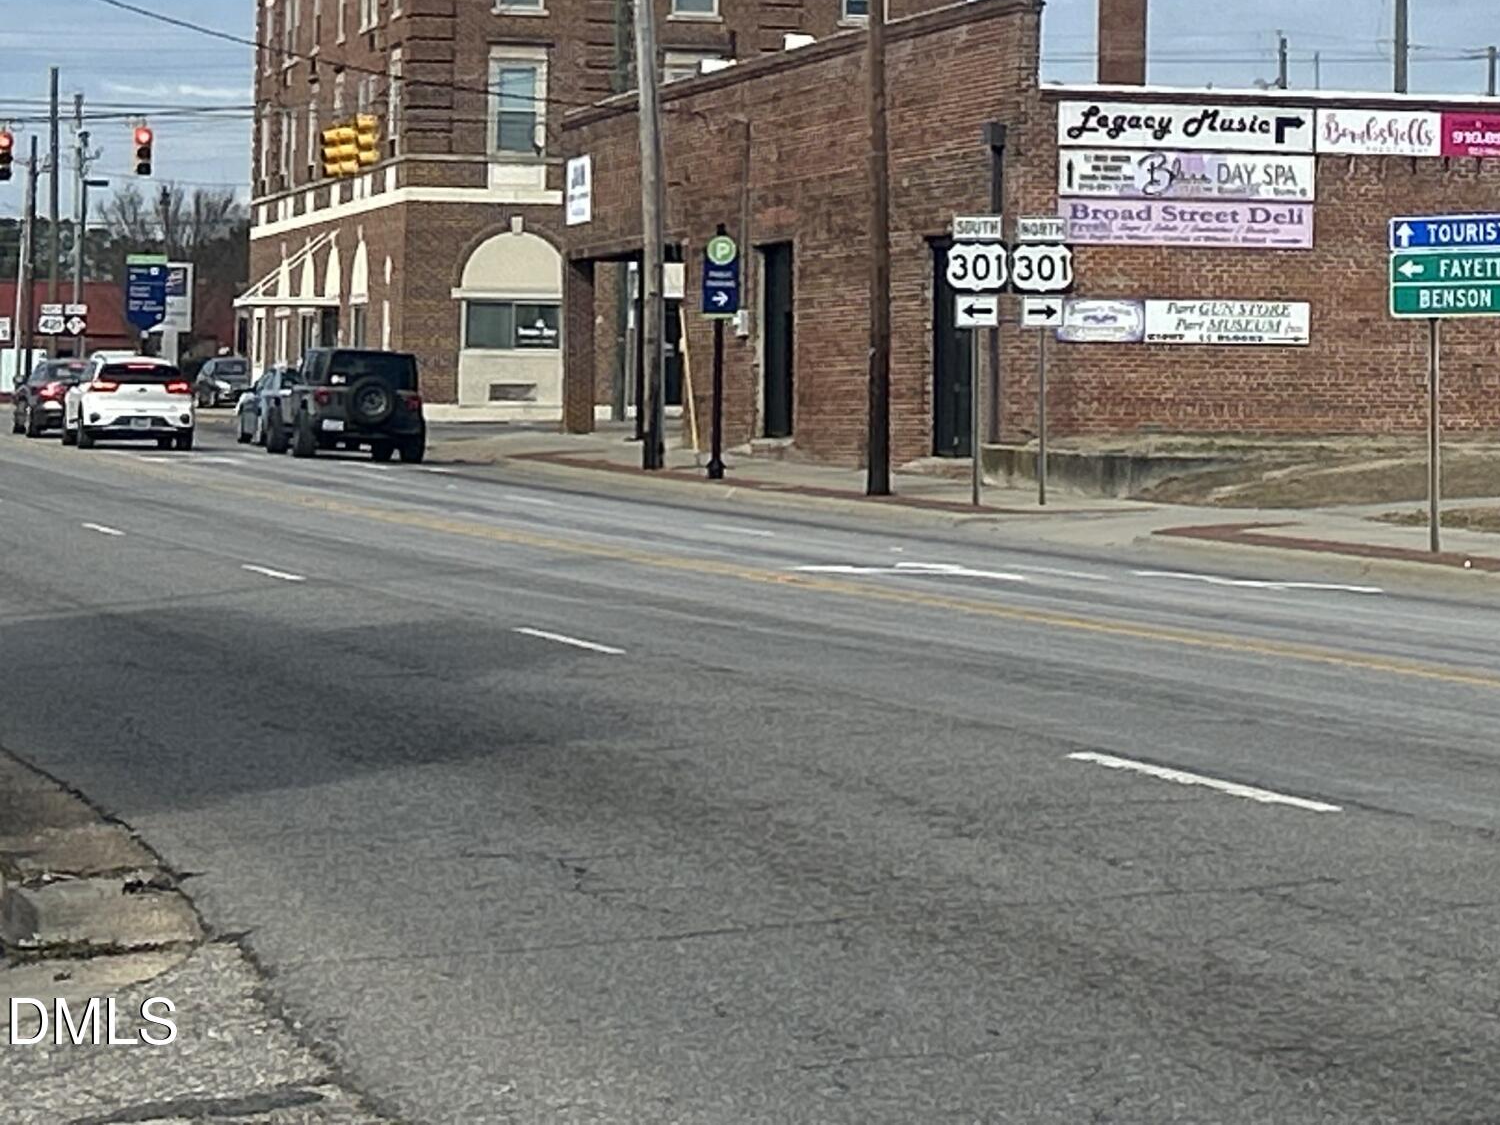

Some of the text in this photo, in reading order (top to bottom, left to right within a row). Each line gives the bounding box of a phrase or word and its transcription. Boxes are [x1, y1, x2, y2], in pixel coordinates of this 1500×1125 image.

[1066, 105, 1271, 140] Legacy Music
[1217, 163, 1256, 185] DAY
[1262, 163, 1298, 187] SPA
[1069, 203, 1303, 225] Broad Street Deli
[957, 220, 999, 234] SOUTH
[1021, 222, 1062, 235] NORTH
[716, 242, 731, 259] P
[952, 254, 1003, 281] 301
[1017, 255, 1068, 281] 301
[1419, 288, 1492, 309] BENSON
[1199, 302, 1235, 316] GUN
[1238, 303, 1292, 317] STORE
[1207, 318, 1282, 333] MUSEUM
